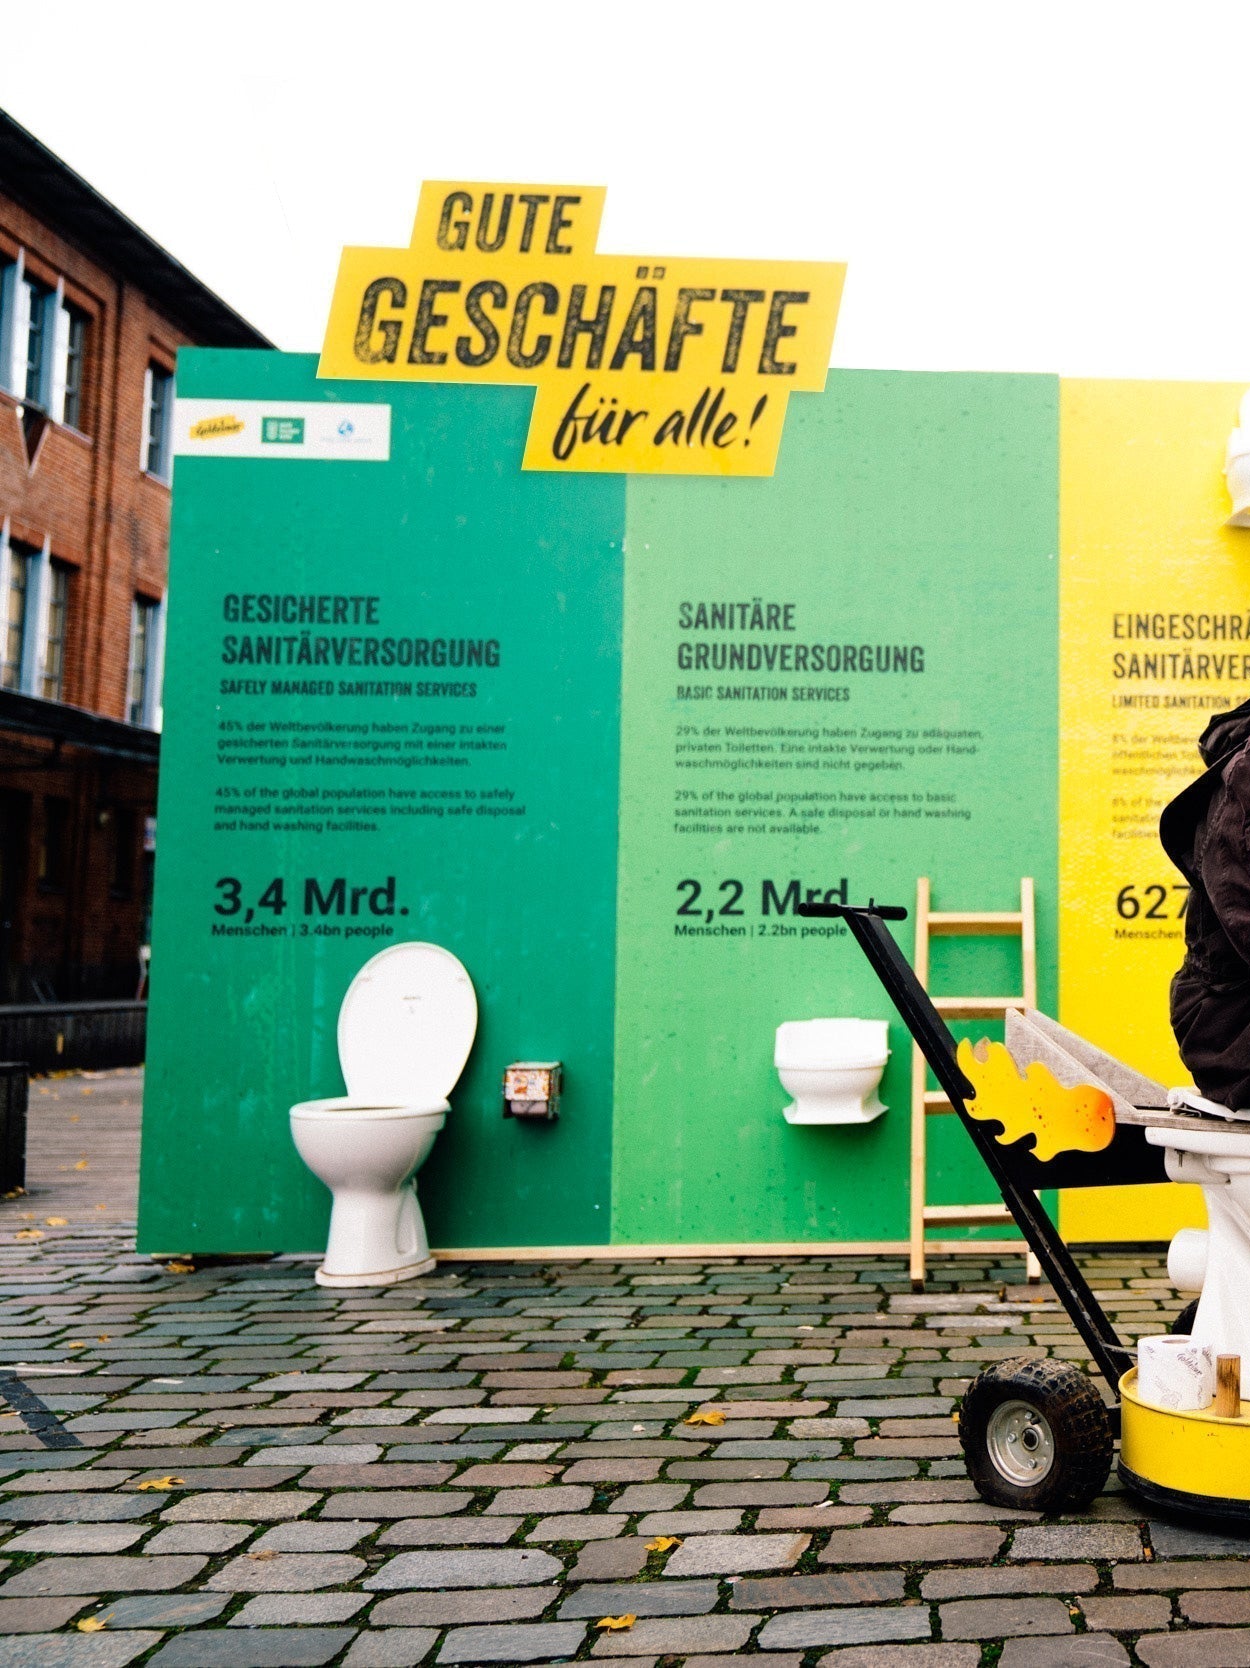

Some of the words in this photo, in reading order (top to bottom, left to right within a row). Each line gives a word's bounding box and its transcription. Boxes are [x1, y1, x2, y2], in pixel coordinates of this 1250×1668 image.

[436, 191, 581, 254] GUTE
[353, 266, 810, 377] GESCHÄFTE
[552, 382, 649, 461] für
[653, 386, 769, 449] alle!
[223, 594, 380, 624] GESICHERTE
[679, 597, 796, 631] SANITÄRE
[221, 630, 500, 667] SANITÄRVERSORGUNG
[678, 642, 925, 673] GRUNDVERSORGUNG
[219, 679, 267, 695] SAFELY
[270, 679, 334, 695] MANAGED
[338, 680, 412, 696] SANITATION
[415, 681, 477, 697] SERVICES
[676, 685, 712, 700] BASIC
[716, 685, 787, 701] SANITATION
[791, 686, 850, 702] SERVICES
[1111, 695, 1160, 708] LIMITED
[1162, 695, 1231, 709] SANITATION
[218, 720, 243, 731] 45%
[246, 721, 266, 732] der
[268, 721, 369, 735] Weltbevölkerung
[371, 722, 408, 733] haben
[411, 722, 456, 736] Zugang
[459, 724, 473, 734] zu
[475, 724, 505, 734] einer
[216, 737, 289, 750] gesicherten
[290, 737, 401, 752] Sanitärversorgung
[403, 739, 423, 749] mit
[425, 740, 456, 750] einer
[458, 739, 507, 750] intakten
[216, 754, 287, 767] Verwertung
[289, 754, 312, 765] und
[215, 786, 241, 797] 45%
[243, 786, 257, 798] of
[259, 787, 279, 798] the
[281, 787, 319, 800] global
[321, 787, 386, 800] population
[387, 787, 417, 799] have
[419, 790, 461, 799] access
[464, 789, 476, 799] to
[479, 788, 515, 801] safely
[214, 803, 271, 817] managed
[274, 803, 334, 815] sanitation
[337, 805, 386, 815] services
[390, 804, 444, 818] including
[447, 804, 472, 815] safe
[475, 804, 525, 817] disposal
[213, 820, 236, 830] and
[239, 819, 270, 831] hand
[272, 820, 323, 833] washing
[215, 877, 286, 922] 3,4
[304, 875, 409, 916] Mrd.
[675, 878, 745, 923] 2,2
[1116, 885, 1189, 919] 627
[211, 921, 287, 936] Menschen
[299, 923, 341, 936] 3.4bn
[344, 923, 394, 939] people
[673, 921, 746, 936] Menschen
[757, 924, 797, 936] 2.2bn
[800, 922, 850, 938] people
[1113, 929, 1181, 939] Menschen
